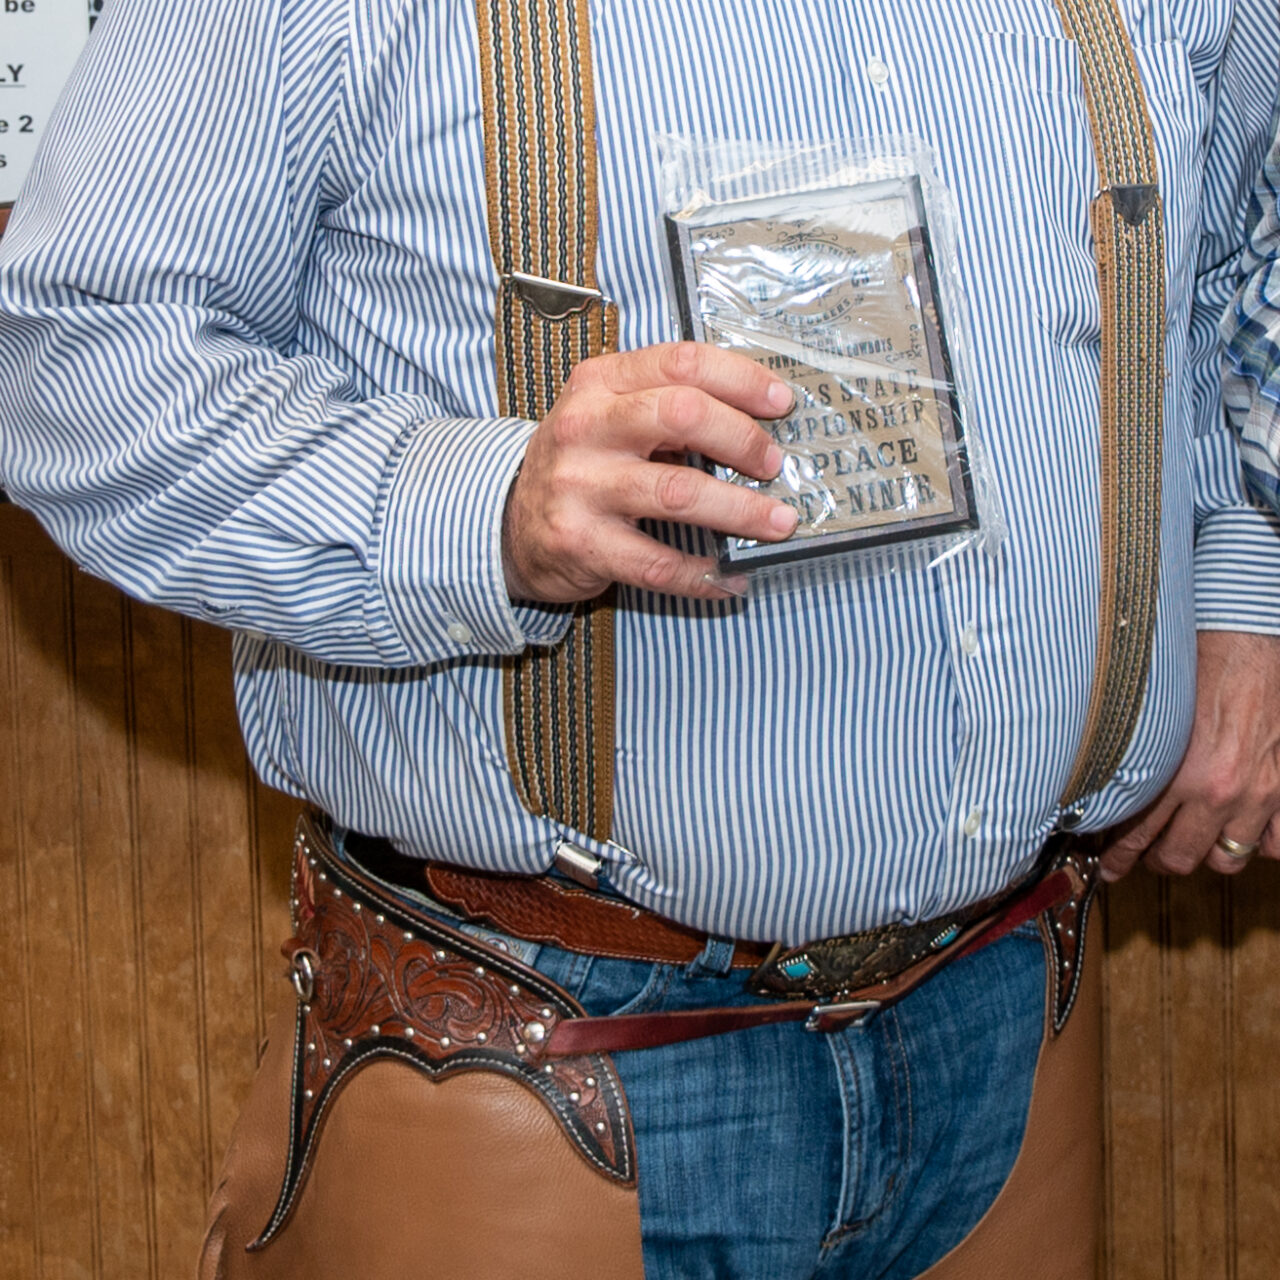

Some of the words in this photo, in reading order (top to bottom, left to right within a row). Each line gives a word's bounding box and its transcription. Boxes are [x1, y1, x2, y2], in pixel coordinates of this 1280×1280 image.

[18, 115, 34, 133] 2
[846, 337, 894, 357] COWBOYS
[840, 369, 920, 402] STATE
[770, 399, 924, 444] AMPIONSHIP
[810, 437, 918, 480] PLACE
